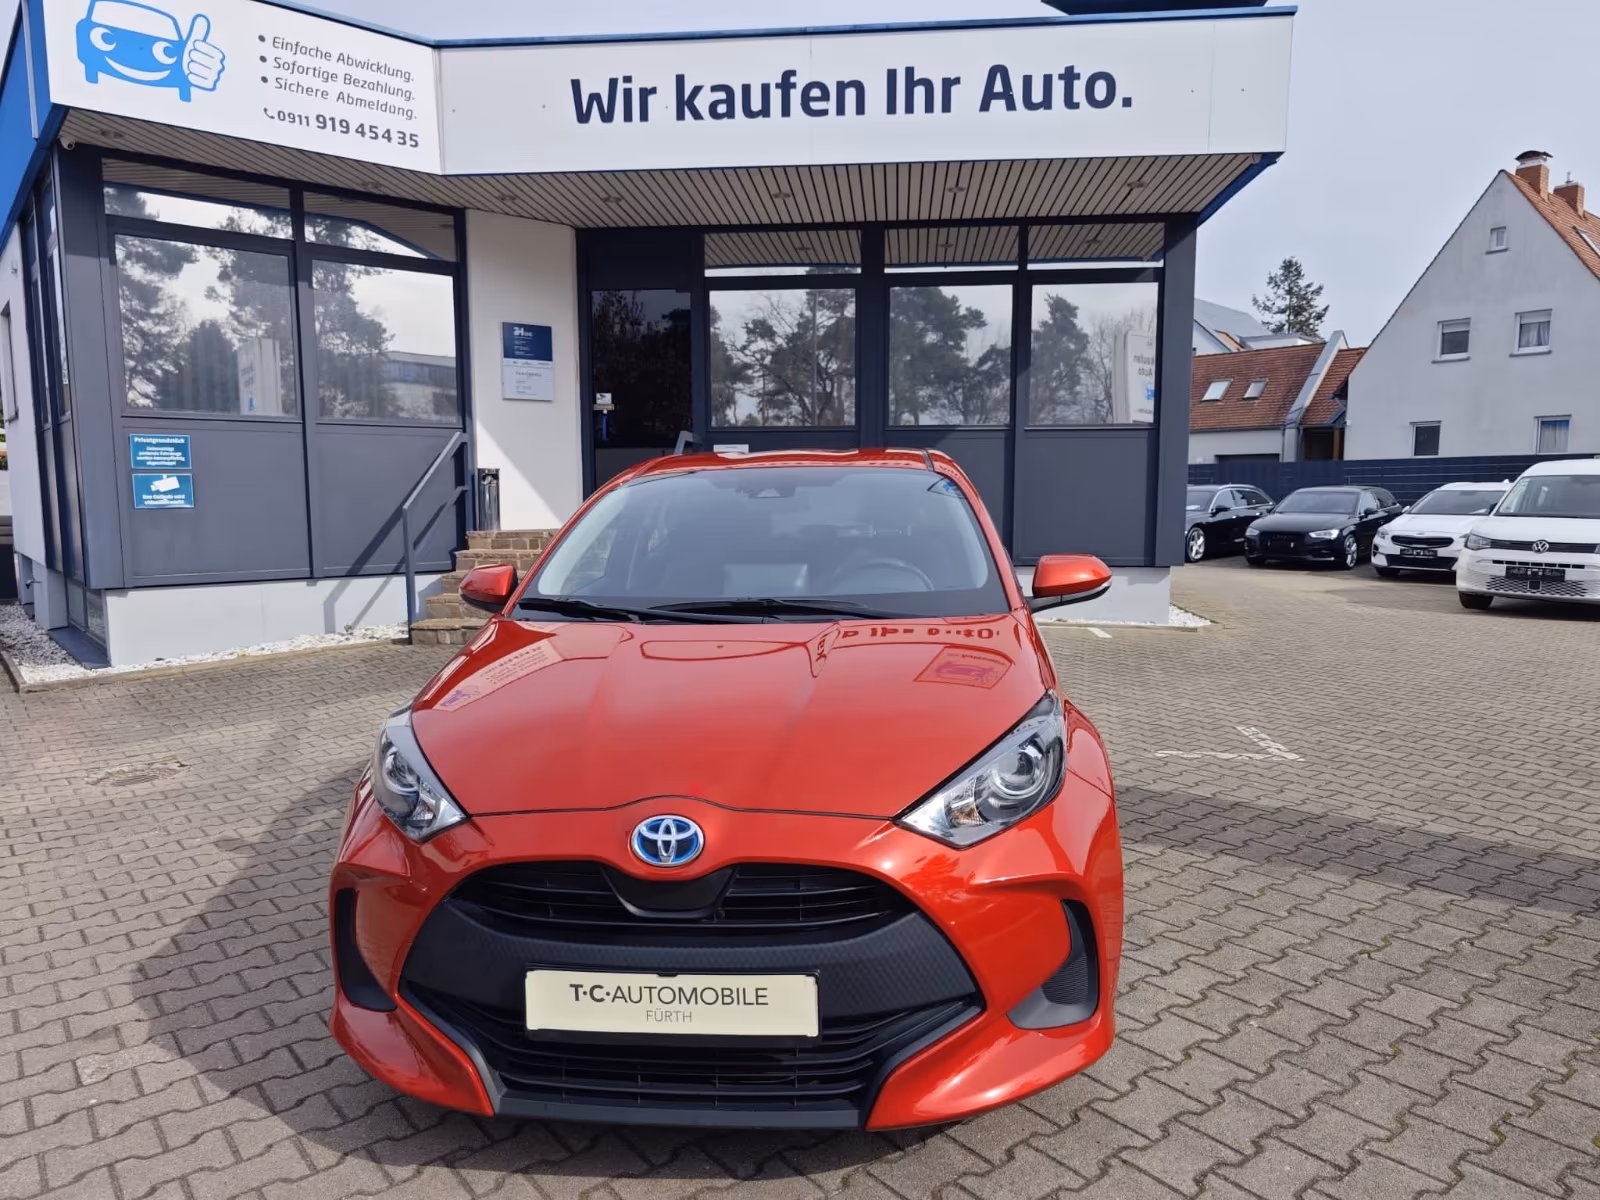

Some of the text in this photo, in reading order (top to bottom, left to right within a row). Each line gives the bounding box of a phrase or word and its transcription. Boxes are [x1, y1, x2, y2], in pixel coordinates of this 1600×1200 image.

[272, 36, 414, 82] Einfache Abwicklung.
[273, 57, 415, 102] Sofortige Bezahlung.
[274, 77, 417, 120] Sichere Abmeldung.
[570, 64, 1134, 124] Wir kaufen Ihr Auto.
[277, 110, 419, 148] 0911 919 454 35
[645, 1007, 693, 1023] FÜRTH
